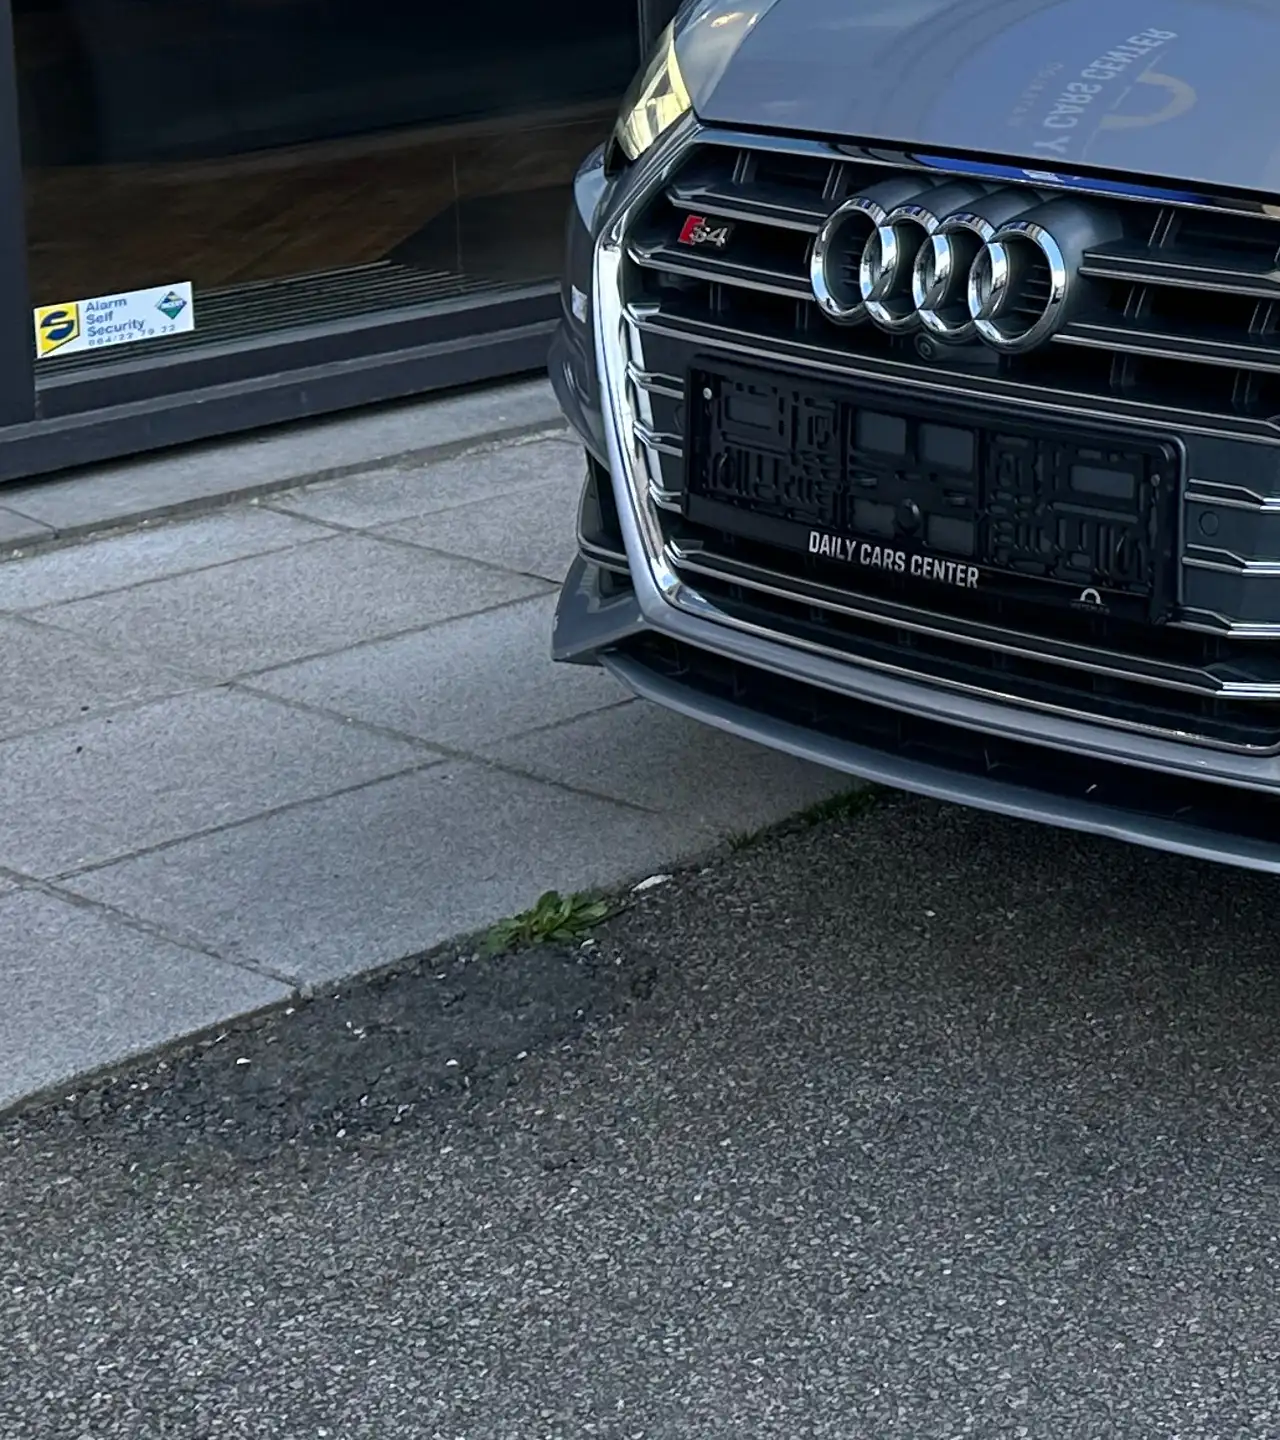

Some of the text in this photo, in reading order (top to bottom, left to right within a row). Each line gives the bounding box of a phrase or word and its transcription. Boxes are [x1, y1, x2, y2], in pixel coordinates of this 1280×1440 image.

[684, 216, 728, 247] S4
[85, 298, 127, 312] Alarm
[86, 311, 113, 325] Self
[87, 319, 145, 337] Security
[808, 530, 980, 589] DAILY CARS CENTER
